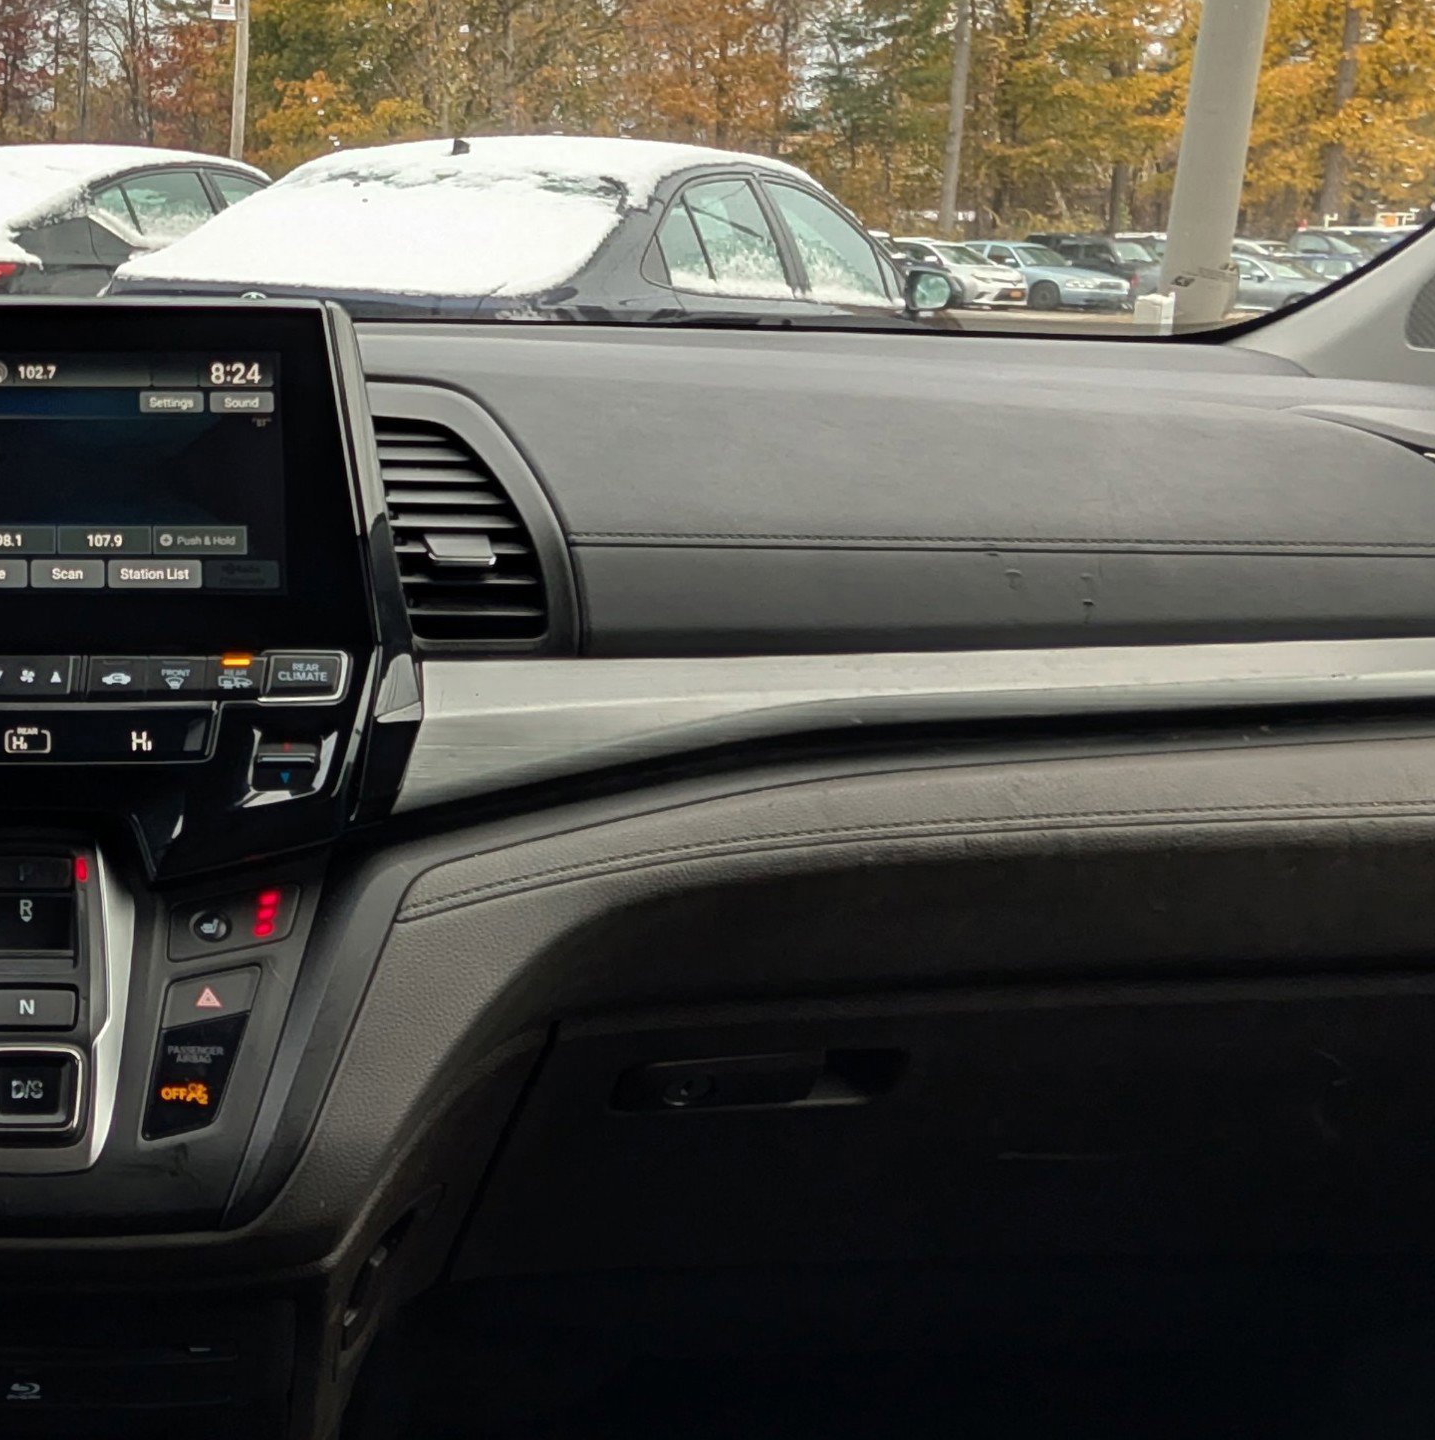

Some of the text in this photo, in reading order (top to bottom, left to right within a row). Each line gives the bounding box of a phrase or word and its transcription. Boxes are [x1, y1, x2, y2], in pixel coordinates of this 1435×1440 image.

[18, 364, 57, 380] 102.7
[209, 362, 262, 385] 8:24
[148, 396, 194, 412] Settings
[224, 396, 260, 410] Sound
[86, 533, 124, 548] 107.9
[176, 534, 202, 547] Push
[212, 534, 237, 547] Hold
[51, 566, 84, 581] Scan
[119, 566, 190, 582] Station List
[292, 662, 321, 674] REAR
[276, 670, 329, 683] CLIMATE
[19, 898, 33, 917] R
[19, 999, 36, 1016] N
[167, 1045, 224, 1058] PASSENGER
[175, 1054, 212, 1064] AIRBAG
[10, 1079, 44, 1101] D/S
[161, 1087, 187, 1101] OFF
